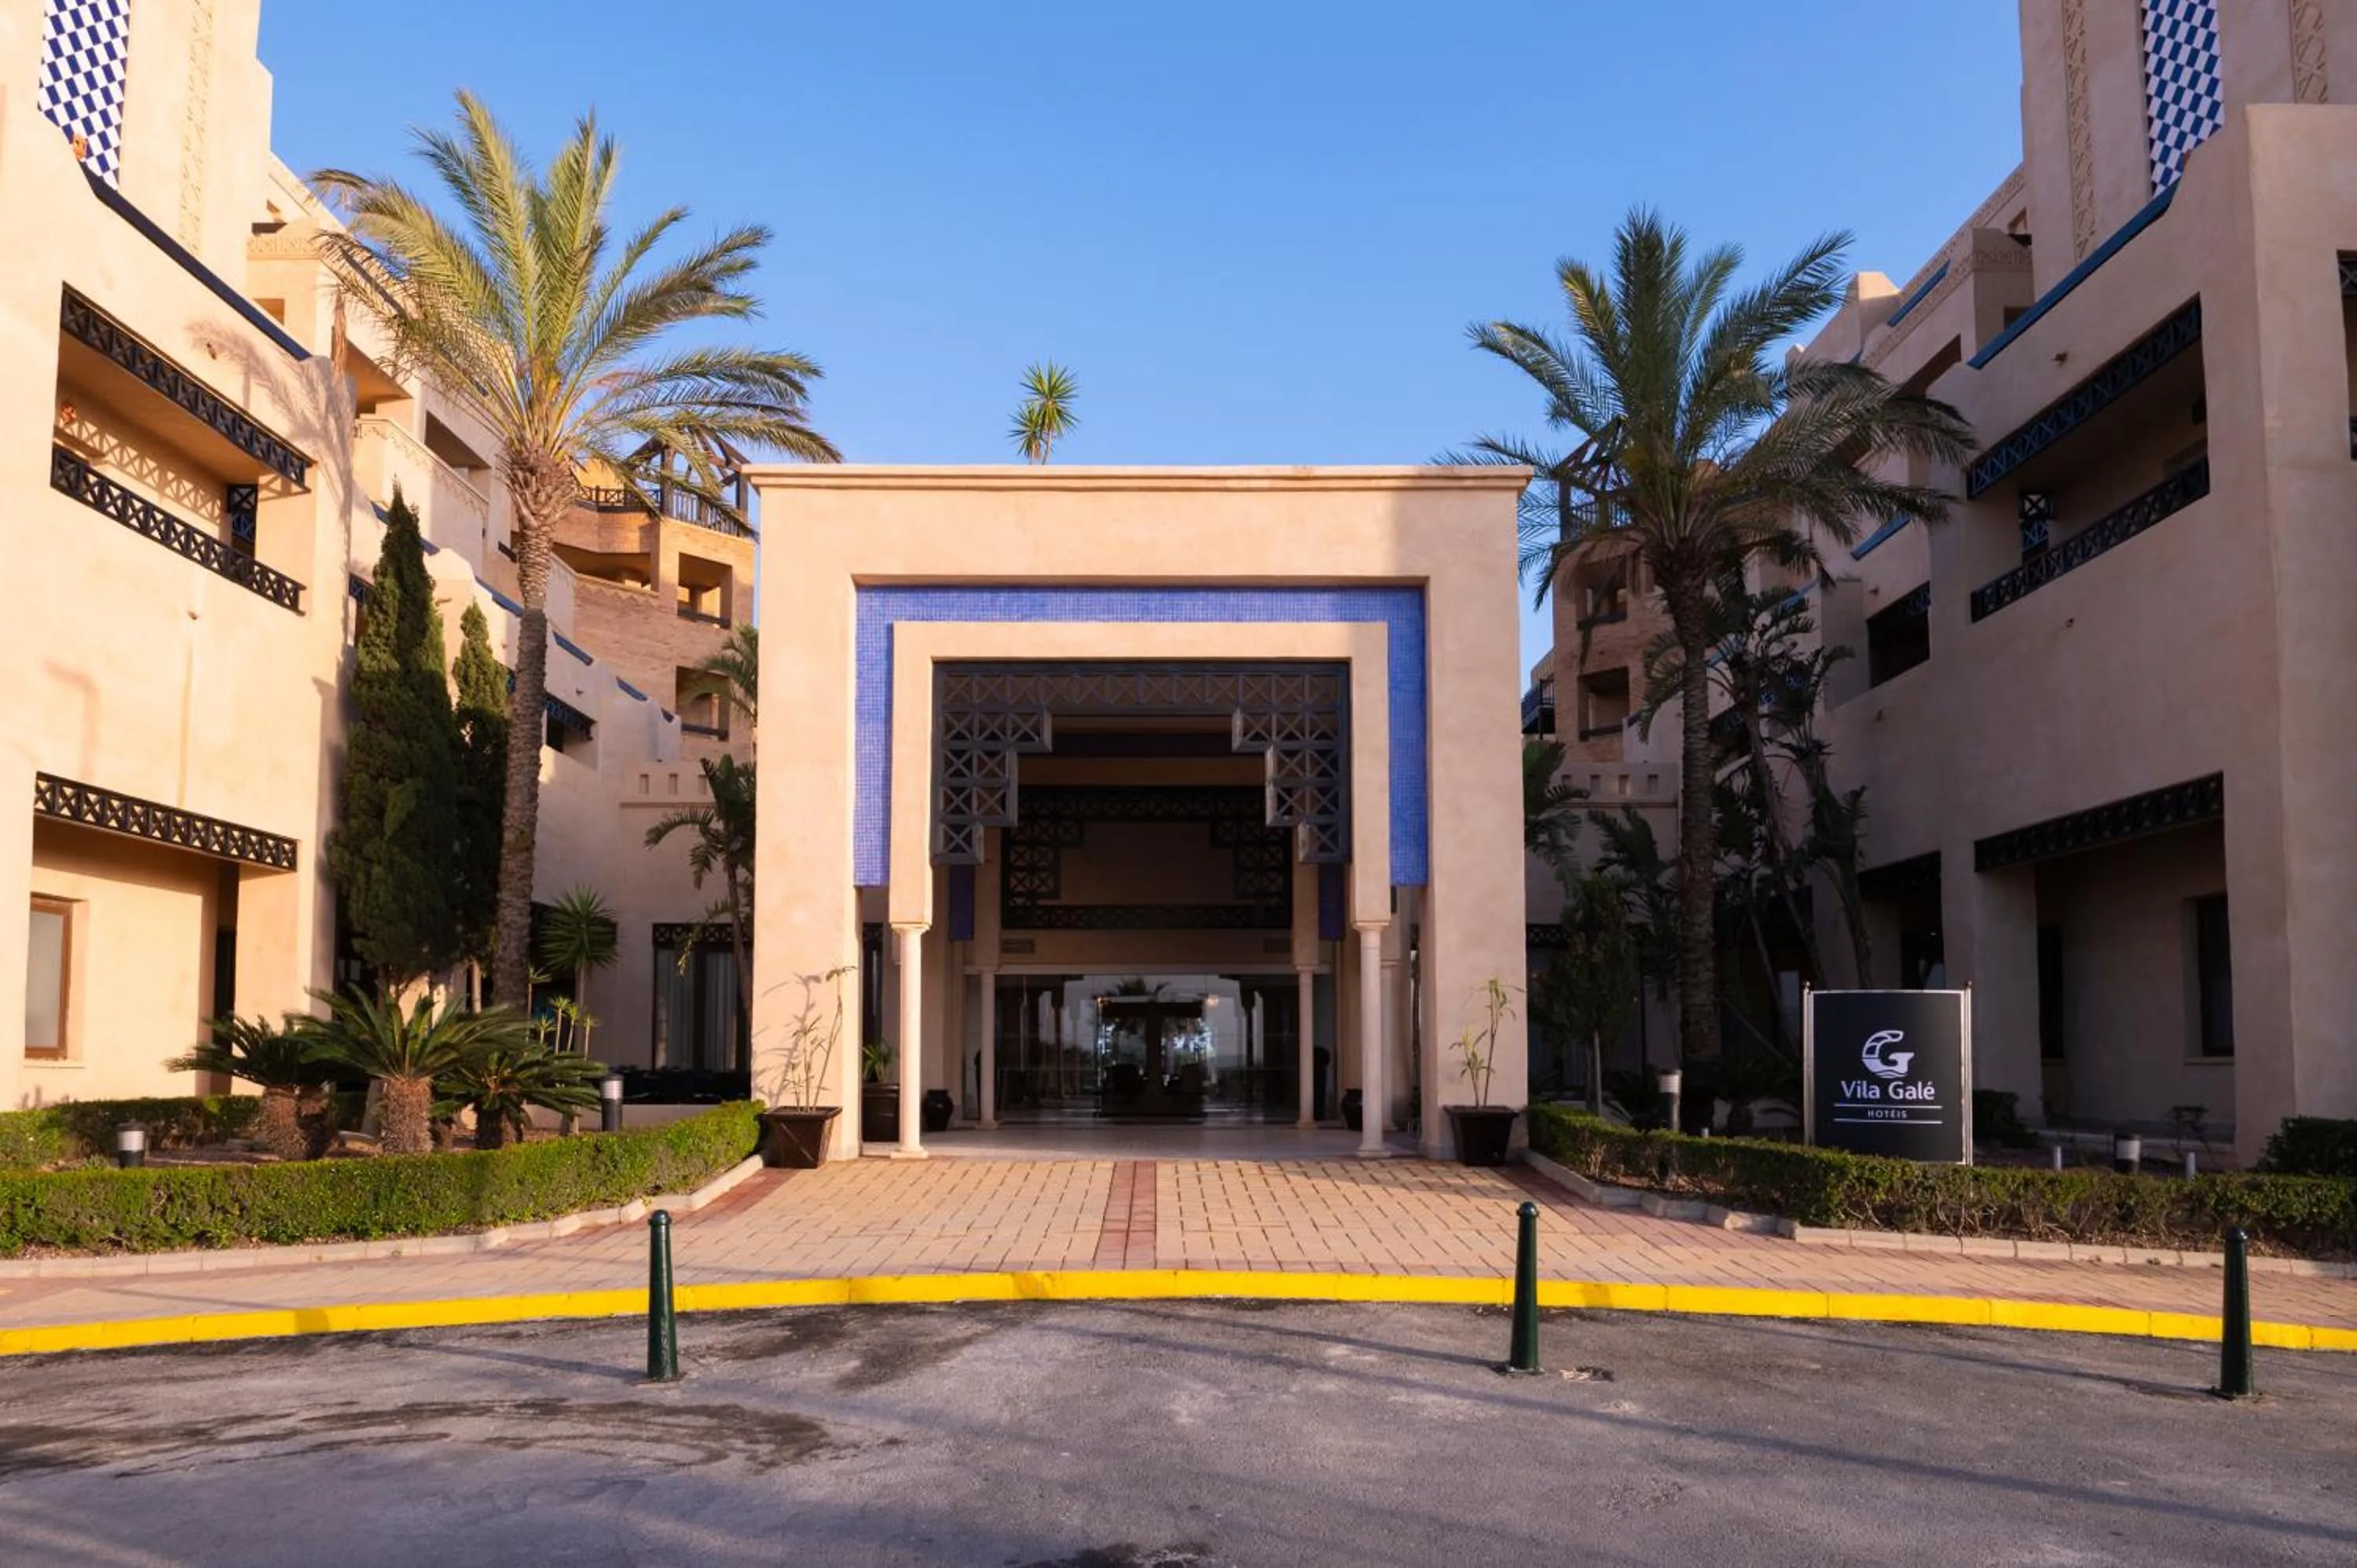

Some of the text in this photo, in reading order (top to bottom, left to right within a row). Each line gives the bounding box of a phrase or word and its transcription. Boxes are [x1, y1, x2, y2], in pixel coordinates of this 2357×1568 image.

[1841, 1080, 1935, 1100] Vila Galé
[1868, 1108, 1908, 1119] HOTÉIS
